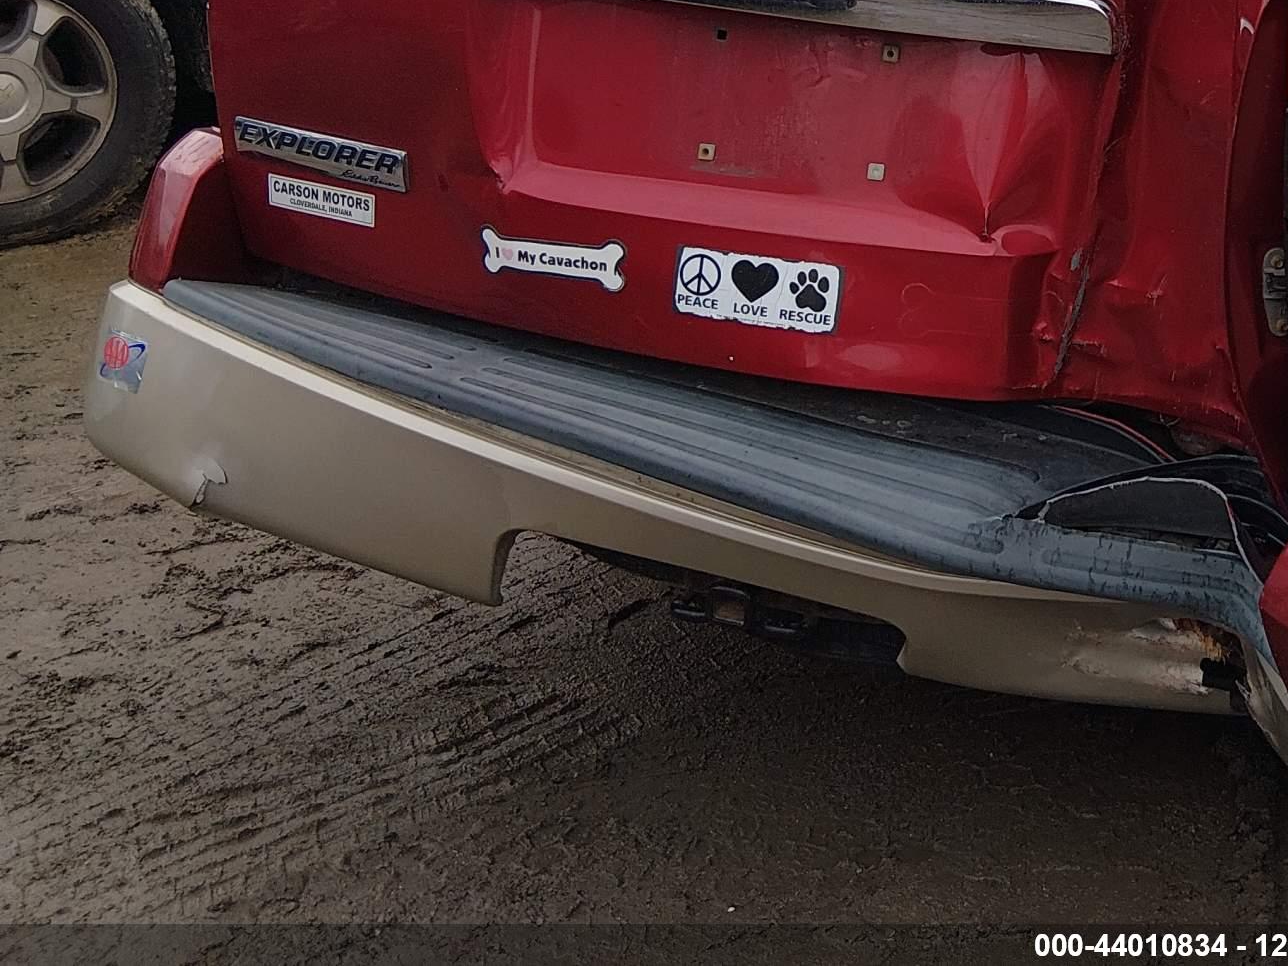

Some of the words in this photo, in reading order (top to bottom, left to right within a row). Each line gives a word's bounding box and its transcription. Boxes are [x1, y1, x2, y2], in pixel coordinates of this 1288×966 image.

[238, 123, 401, 174] EXPLORER
[273, 180, 319, 201] CARSON
[322, 191, 370, 212] MOTORS
[289, 198, 328, 213] CLOVERDALE,
[328, 206, 353, 218] INDIANA
[517, 251, 537, 267] My
[539, 251, 608, 273] Cavachon
[677, 294, 719, 310] PEACE
[733, 302, 768, 318] LOVE
[778, 309, 831, 326] RESCUE
